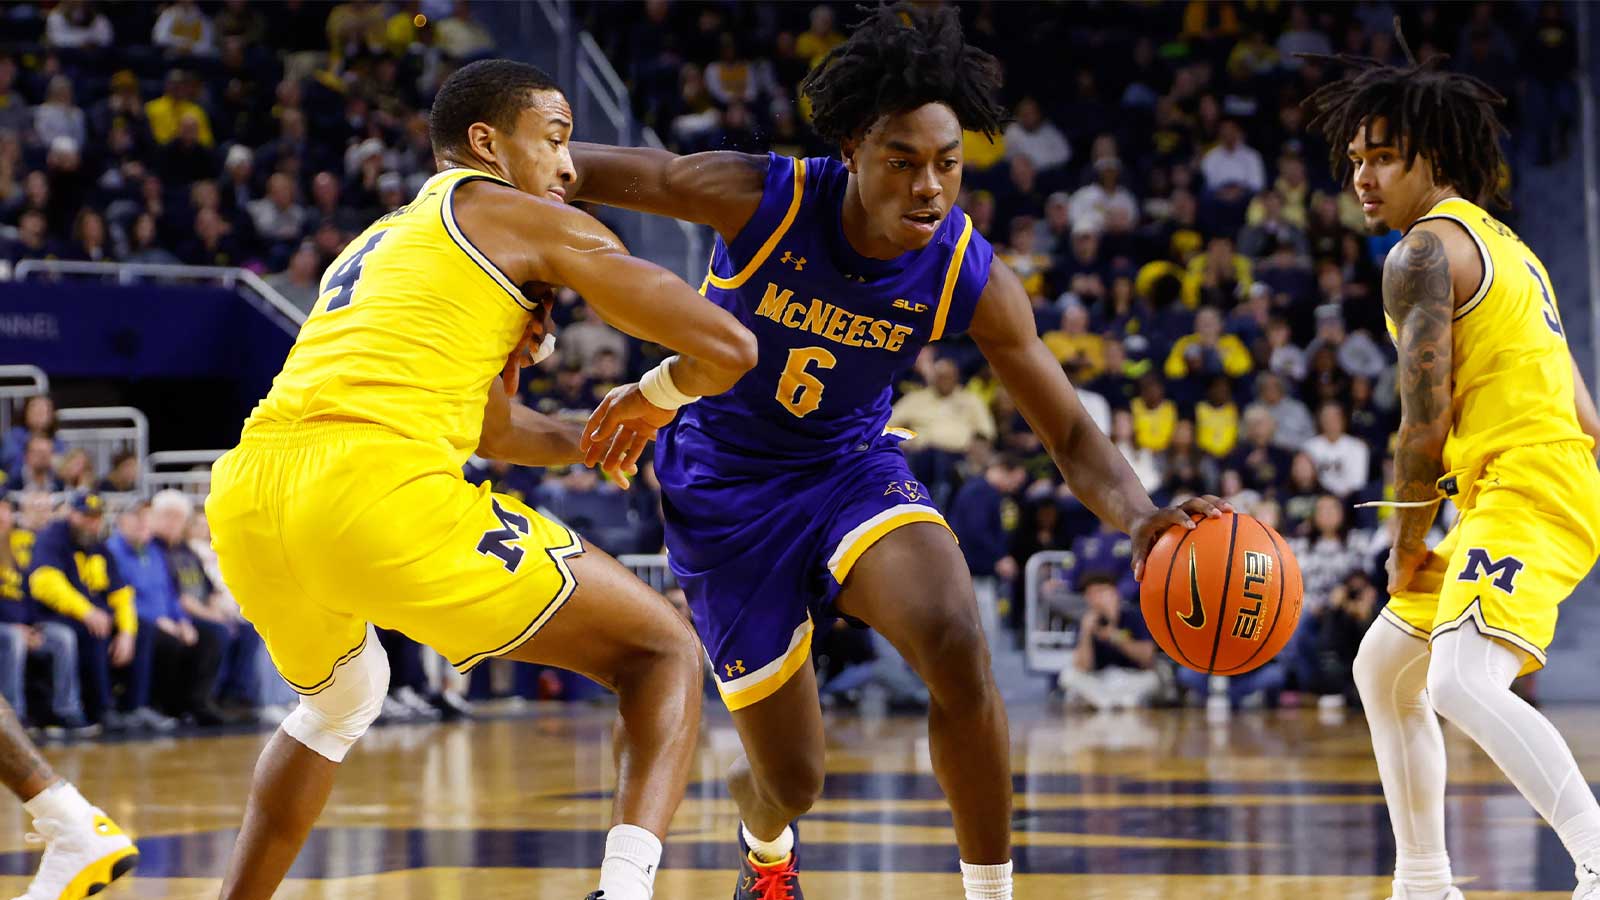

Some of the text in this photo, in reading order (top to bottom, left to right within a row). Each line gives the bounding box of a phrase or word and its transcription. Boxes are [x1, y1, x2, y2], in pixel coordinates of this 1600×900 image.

[322, 229, 388, 312] 4
[775, 346, 837, 419] 6
[476, 494, 530, 575] M
[1457, 547, 1524, 595] M
[1231, 550, 1268, 640] ELITE
